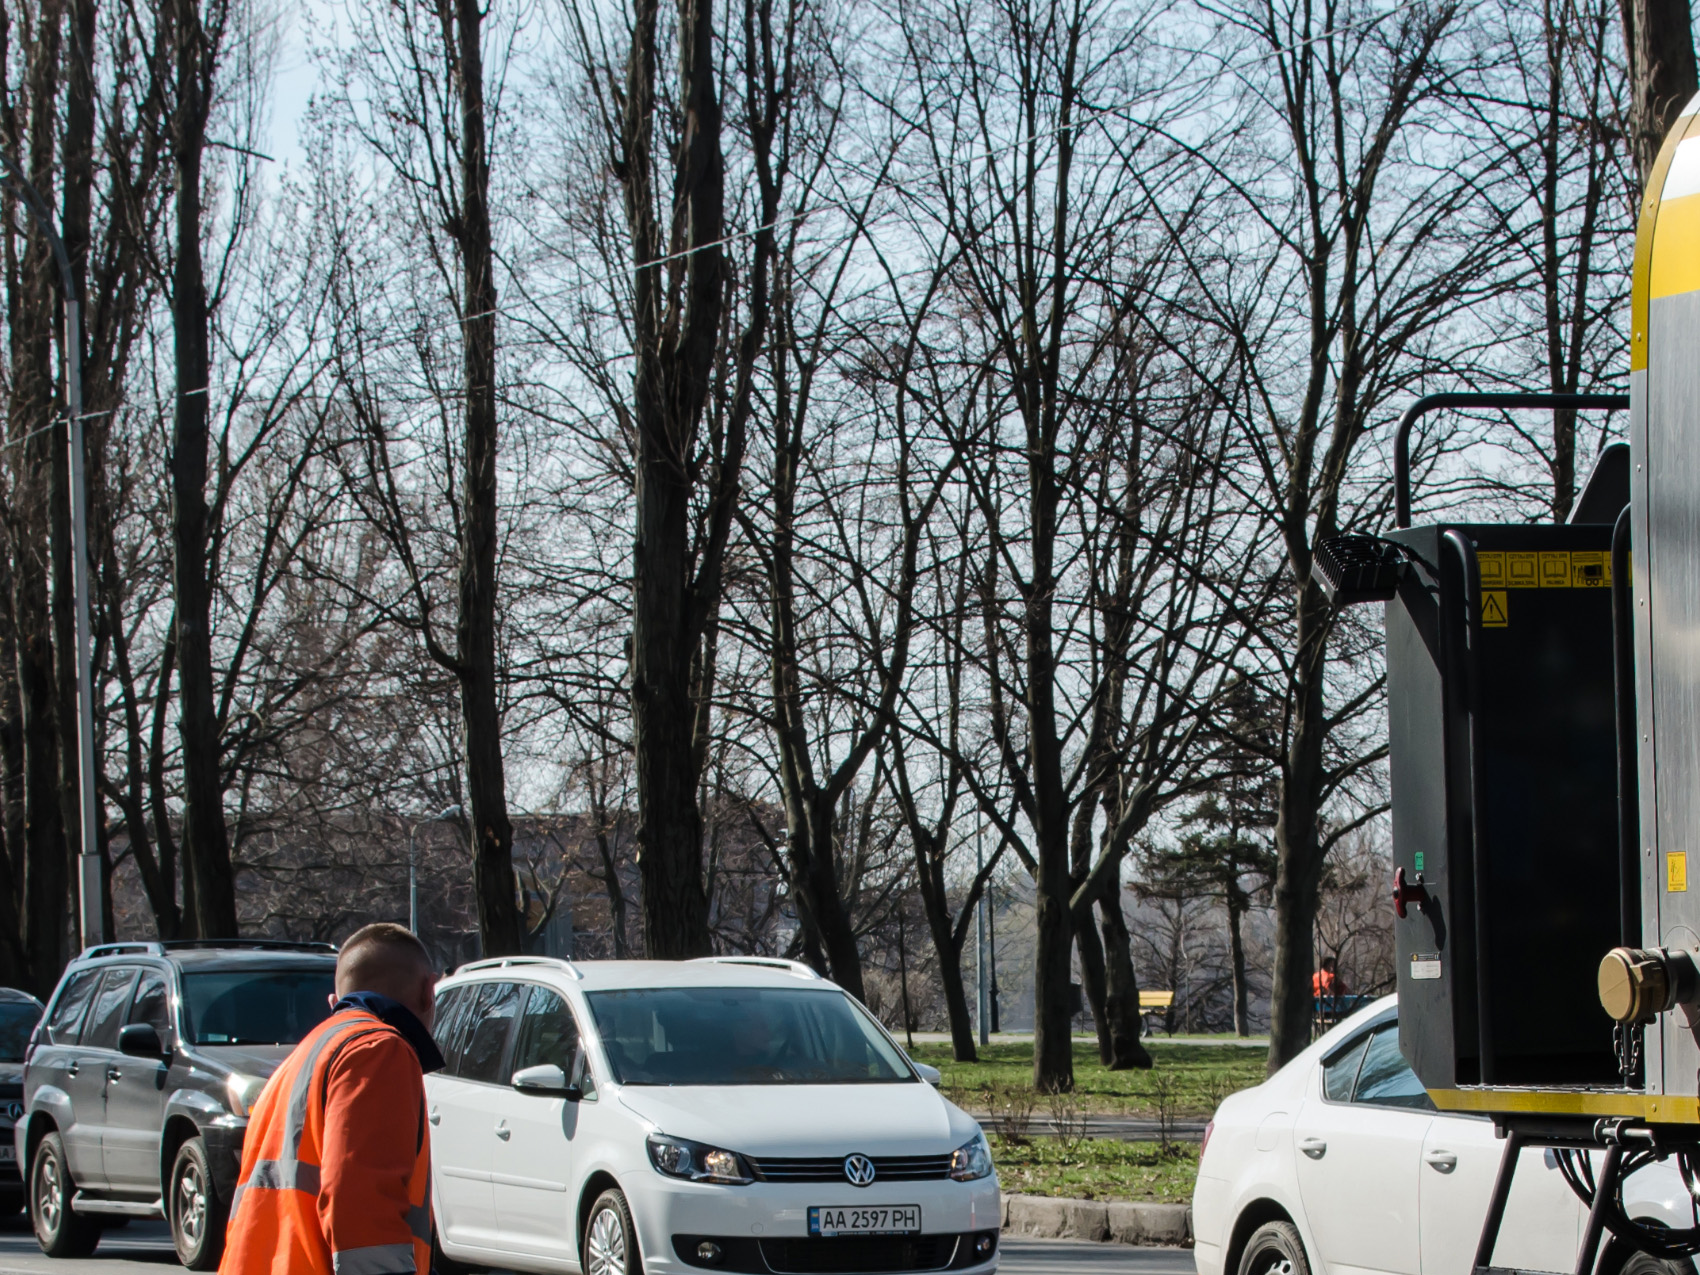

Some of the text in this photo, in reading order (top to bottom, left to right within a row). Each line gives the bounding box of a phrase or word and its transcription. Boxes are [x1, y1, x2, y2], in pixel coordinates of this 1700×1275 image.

[823, 1209, 915, 1229] AA 2597 PH
